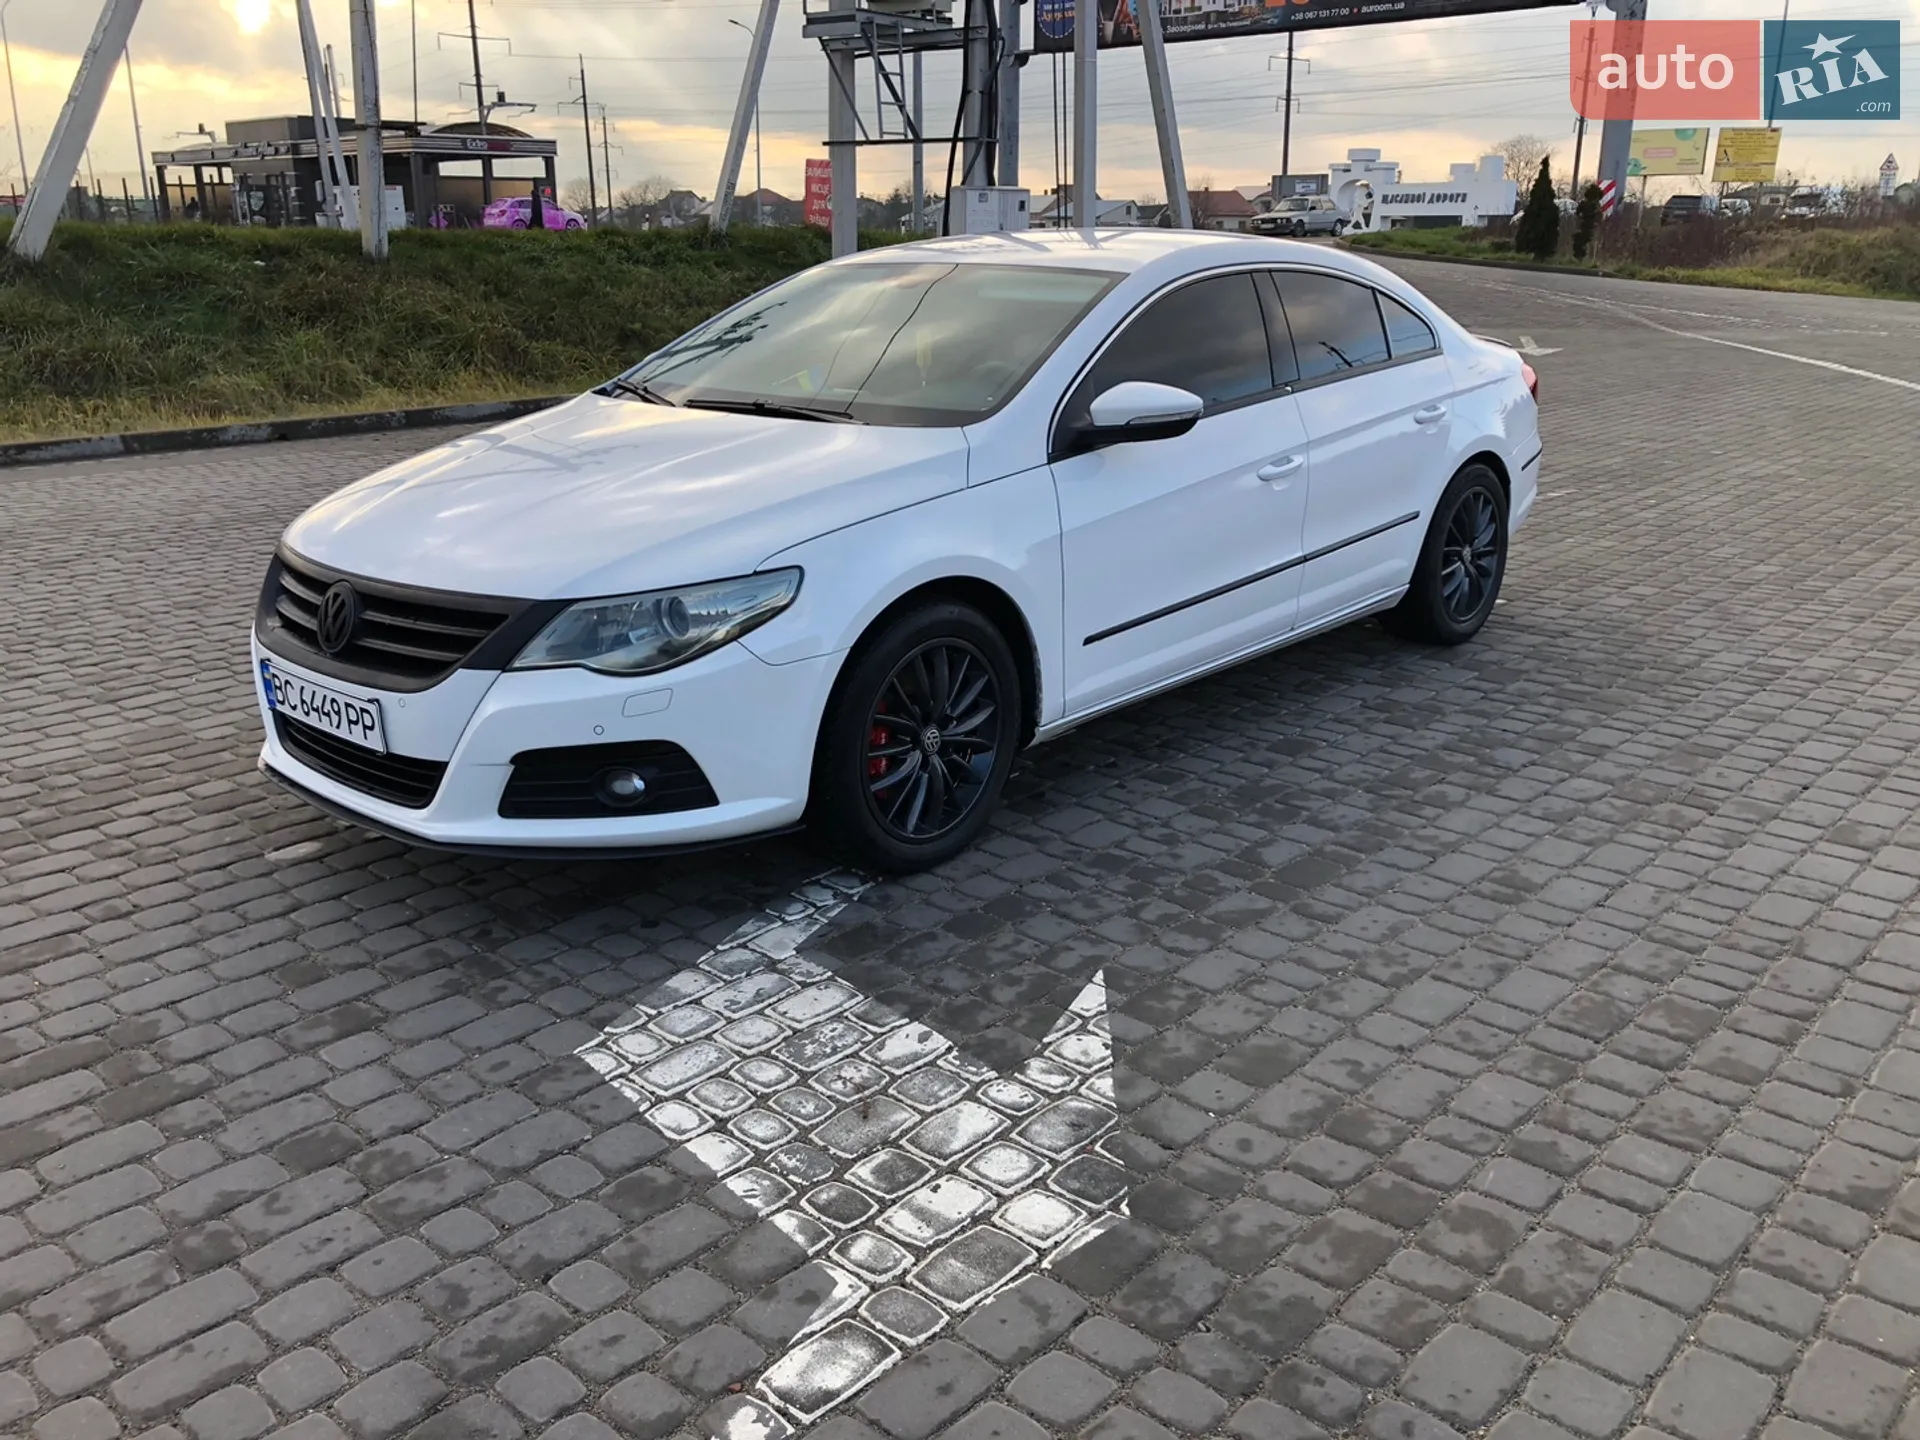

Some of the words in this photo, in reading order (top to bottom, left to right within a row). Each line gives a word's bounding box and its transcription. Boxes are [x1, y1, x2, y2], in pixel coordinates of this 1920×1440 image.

[1318, 9, 1330, 18] 131
[1330, 8, 1340, 17] 77
[1340, 7, 1350, 16] 00
[1361, 2, 1406, 13] auroom.ua
[1166, 21, 1206, 34] Заозерний
